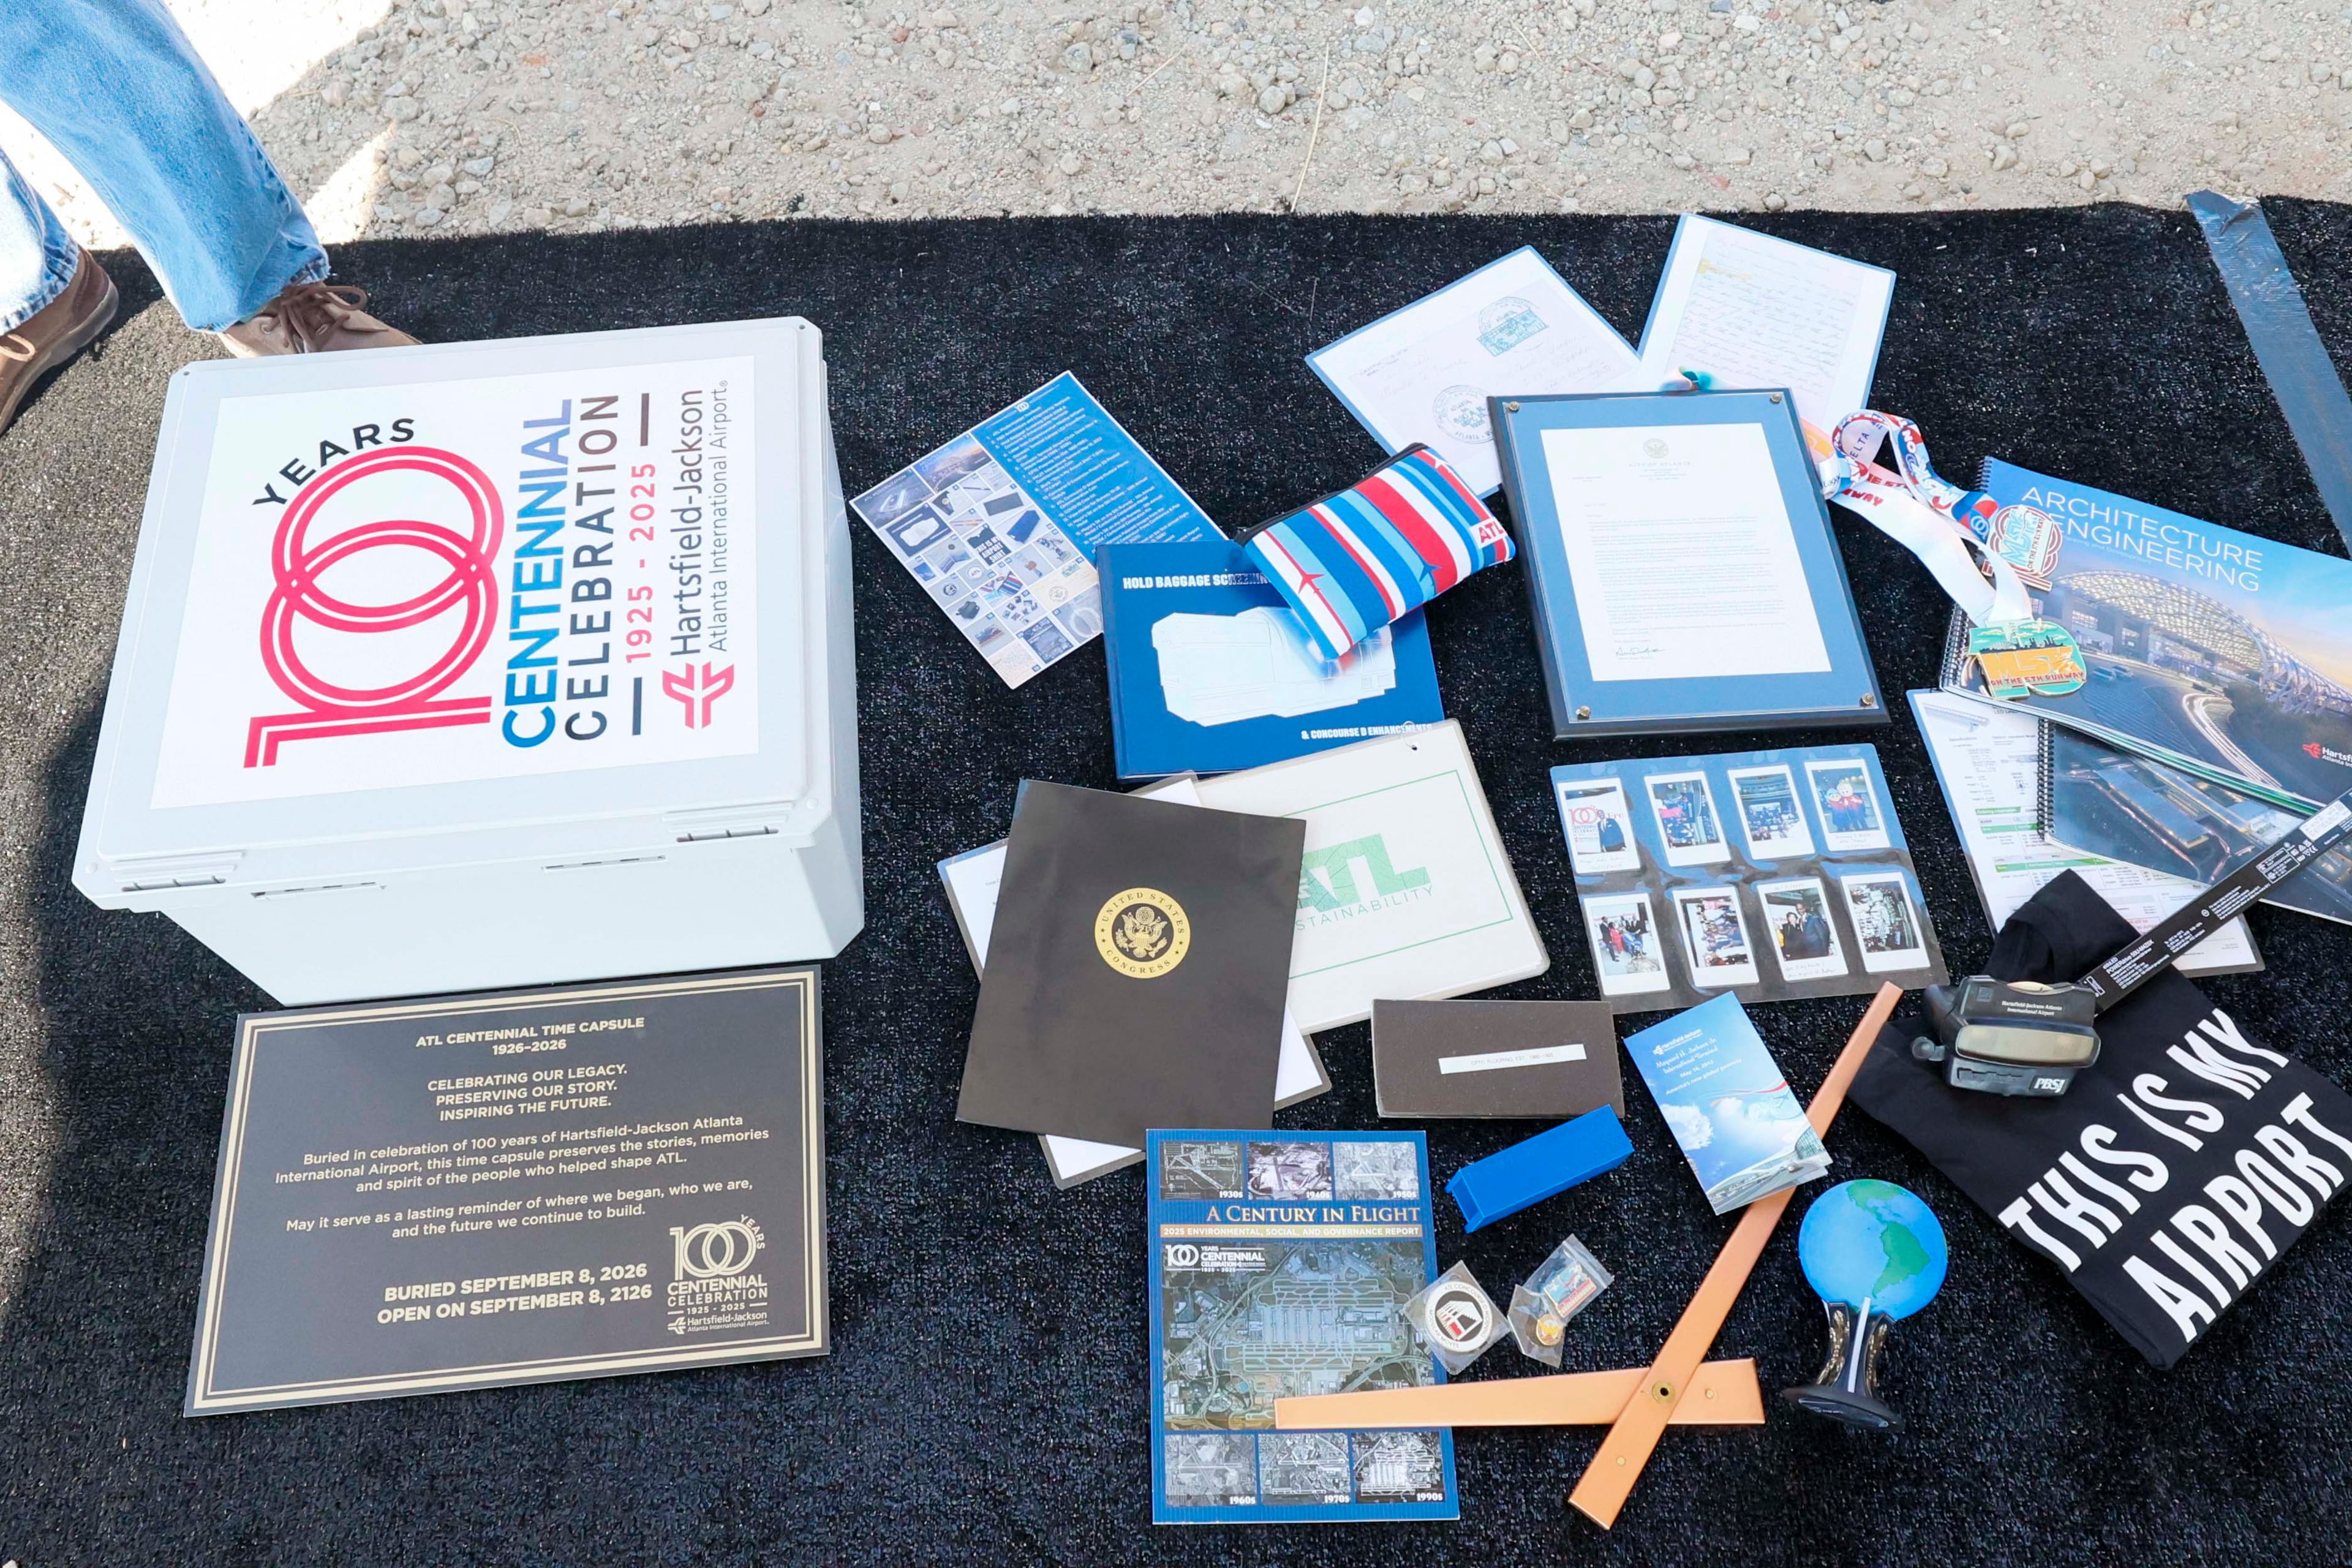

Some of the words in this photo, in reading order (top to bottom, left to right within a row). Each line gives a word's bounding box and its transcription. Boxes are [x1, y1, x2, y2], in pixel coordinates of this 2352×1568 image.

[252, 418, 415, 510] YEARS
[1850, 432, 1870, 458] ELTA
[629, 463, 656, 540] 2025
[707, 456, 727, 575] International
[669, 390, 704, 656] Hartsfield-Jackson
[1479, 521, 1504, 543] ATL
[2022, 486, 2263, 571] ARCHITECTURE
[565, 395, 619, 740] CELEBRATION
[2048, 512, 2261, 592] ENGINEERING
[502, 399, 571, 748] CENTENNIAL
[1123, 576, 1153, 589] HOLD
[1155, 575, 1211, 588] BAGGAGE
[1212, 573, 1269, 587] SCREENIN
[626, 586, 652, 663] 1925
[707, 580, 728, 652] Atlanta
[2045, 672, 2083, 680] RUNWAY
[1301, 730, 1310, 740] &
[1310, 727, 1360, 739] CONCOURSE
[1360, 728, 1367, 737] D
[1102, 892, 1143, 922] UNITED
[1150, 894, 1185, 933] STATES
[1295, 885, 1433, 930] STAINABILITY
[1106, 949, 1170, 973] CONGRESS
[415, 1035, 443, 1047] ATL
[446, 1027, 538, 1044] CENTENNIAL
[541, 1023, 576, 1036] TIME
[579, 1017, 644, 1033] CAPSULE
[2166, 1008, 2290, 1101] MY
[428, 1072, 528, 1091] CELEBRATING
[532, 1069, 564, 1082] OUR
[568, 1063, 627, 1079] LEGACY.
[436, 1088, 528, 1106] PRESERVING
[532, 1085, 564, 1097] OUR
[567, 1079, 617, 1094] STORY.
[440, 1104, 514, 1121] INSPIRING
[518, 1101, 546, 1114] THE
[551, 1096, 611, 1111] FUTURE.
[2116, 1072, 2225, 1153] IS
[275, 1164, 364, 1184] International
[368, 1160, 423, 1175] Airport,
[427, 1157, 452, 1170] this
[456, 1155, 488, 1167] time
[491, 1148, 545, 1164] capsule
[549, 1144, 616, 1161] preserves
[620, 1140, 643, 1152] the
[646, 1136, 696, 1150] stories,
[701, 1129, 769, 1145] memories
[303, 1150, 350, 1165] Buried
[353, 1149, 366, 1161] in
[370, 1142, 448, 1159] celebration
[452, 1139, 468, 1152] of
[471, 1137, 497, 1150] 100
[500, 1136, 538, 1149] years
[541, 1131, 557, 1144] of
[560, 1121, 689, 1142] Hartsfield-Jackson
[693, 1115, 743, 1129] Atlanta
[356, 1178, 383, 1193] and
[386, 1175, 423, 1191] spirit
[426, 1173, 442, 1186] of
[445, 1172, 468, 1184] the
[472, 1167, 521, 1184] people
[524, 1164, 555, 1177] who
[559, 1158, 606, 1174] helped
[611, 1156, 652, 1169] shape
[656, 1152, 687, 1165] ATL.
[286, 1219, 315, 1232] May
[319, 1216, 330, 1229] it
[333, 1215, 371, 1227] serve
[374, 1213, 391, 1223] as
[394, 1212, 403, 1221] a
[407, 1206, 454, 1220] lasting
[458, 1199, 522, 1215] reminder
[526, 1196, 542, 1209] of
[545, 1194, 589, 1207] where
[592, 1193, 612, 1203] we
[617, 1188, 665, 1201] began,
[669, 1183, 699, 1196] who
[703, 1182, 723, 1193] we
[726, 1180, 753, 1190] are,
[1206, 1205, 1221, 1221] A
[1322, 1208, 1344, 1222] IN
[1219, 1190, 1243, 1199] 1930s
[1306, 1190, 1331, 1199] 1940s
[1393, 1190, 1417, 1199] 1950s
[1997, 1123, 2170, 1273] THIS
[391, 1224, 419, 1238] and
[423, 1223, 447, 1235] the
[450, 1220, 493, 1233] future
[497, 1218, 518, 1228] we
[521, 1212, 583, 1226] continue
[587, 1208, 603, 1219] to
[606, 1203, 646, 1218] build.
[740, 1213, 766, 1250] YEARS
[1164, 1227, 1186, 1237] 2025
[1187, 1227, 1264, 1238] ENVIRONMENTAL,
[1265, 1227, 1301, 1238] SOCIAL,
[1302, 1227, 1321, 1237] AND
[1323, 1227, 1384, 1237] GOVERNANCE
[1385, 1227, 1419, 1237] REPORT
[2122, 1091, 2352, 1344] AIRPORT
[669, 1221, 757, 1281] 100
[1200, 1252, 1265, 1261] CENTENNIAL
[385, 1281, 456, 1302] BURIED
[460, 1270, 574, 1294] SEPTEMBER
[578, 1268, 595, 1285] 8,
[600, 1263, 647, 1281] 2026
[667, 1274, 767, 1295] CENTENNIAL
[667, 1287, 767, 1307] CELEBRATION
[377, 1305, 431, 1324] OPEN
[435, 1302, 465, 1318] ON
[469, 1291, 584, 1315] SEPTEMBER
[588, 1289, 605, 1306] 8,
[610, 1284, 652, 1302] 2126
[687, 1305, 709, 1315] 1925
[720, 1302, 745, 1312] 2025
[687, 1311, 767, 1326] Hartsfield-Jackson
[687, 1324, 709, 1333] Atlanta
[709, 1321, 746, 1331] International
[1229, 1496, 1256, 1505] 1960s
[1324, 1494, 1350, 1504] 1970s
[1416, 1493, 1443, 1501] 1990s
